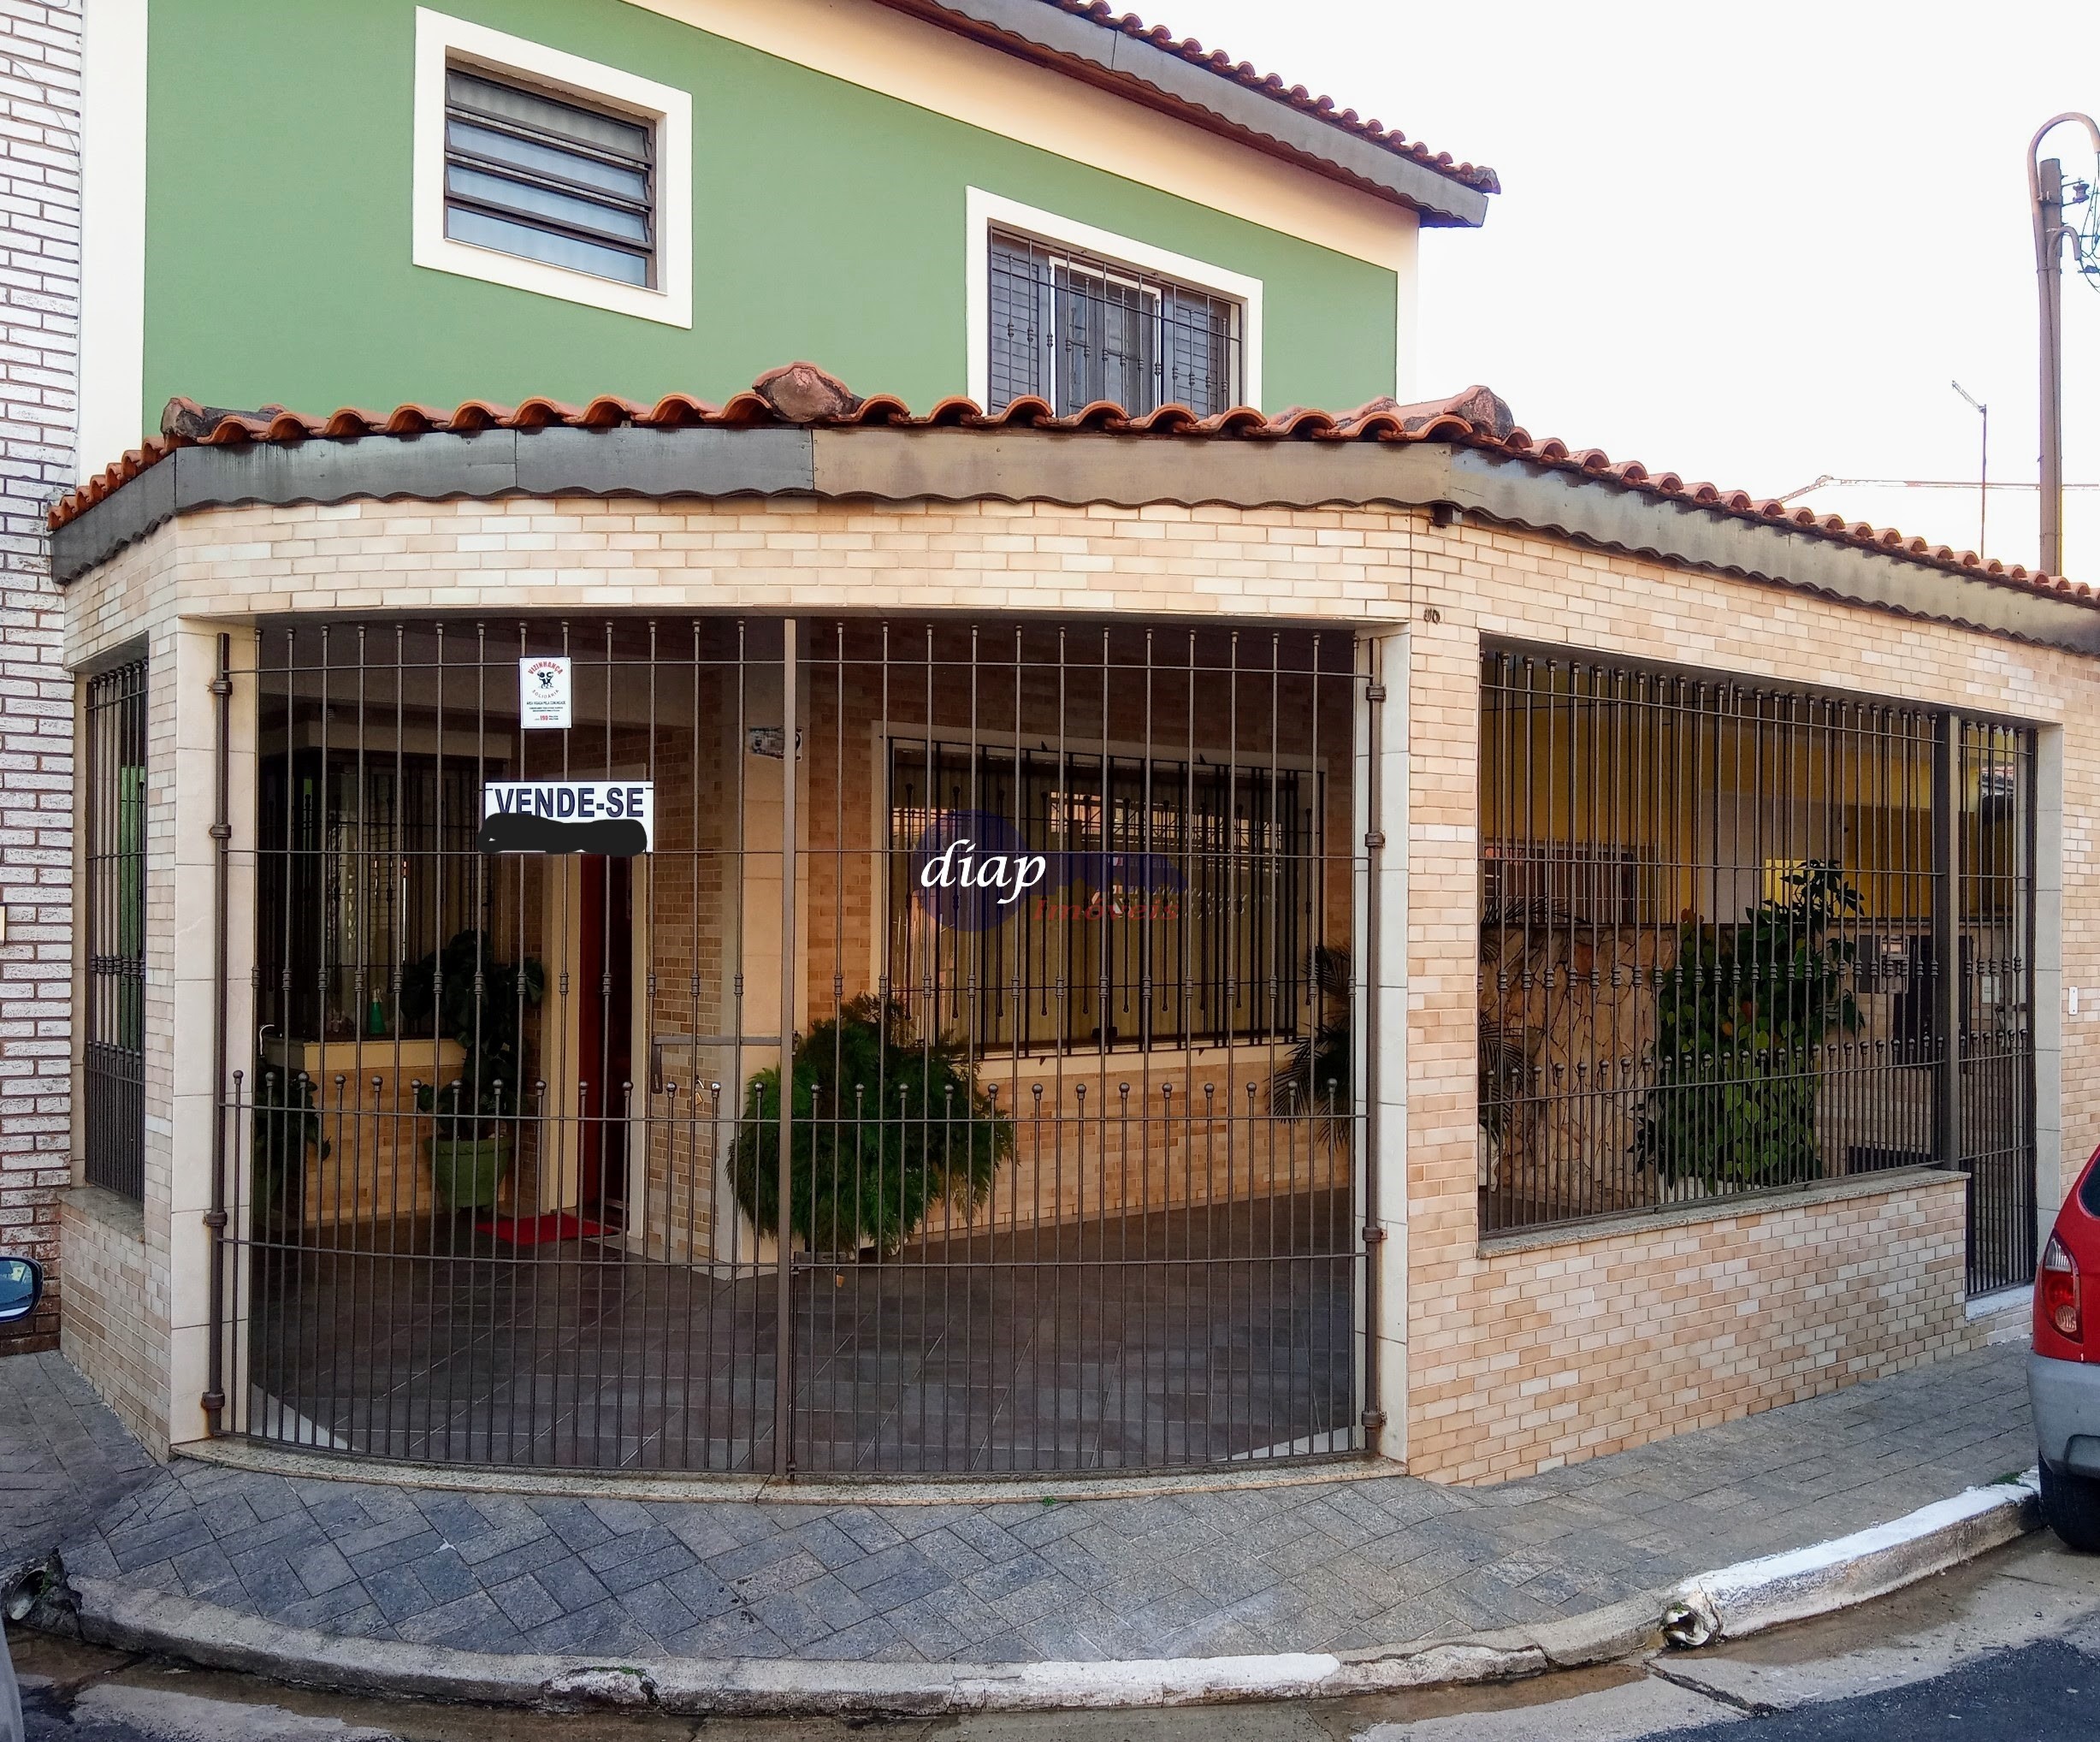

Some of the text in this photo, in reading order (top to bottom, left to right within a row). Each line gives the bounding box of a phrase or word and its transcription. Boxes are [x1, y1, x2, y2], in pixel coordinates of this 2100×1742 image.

[528, 661, 564, 675] VIZINHANÇA
[532, 689, 559, 699] SOLIDÁRIA
[494, 787, 644, 818] VENDE-SE
